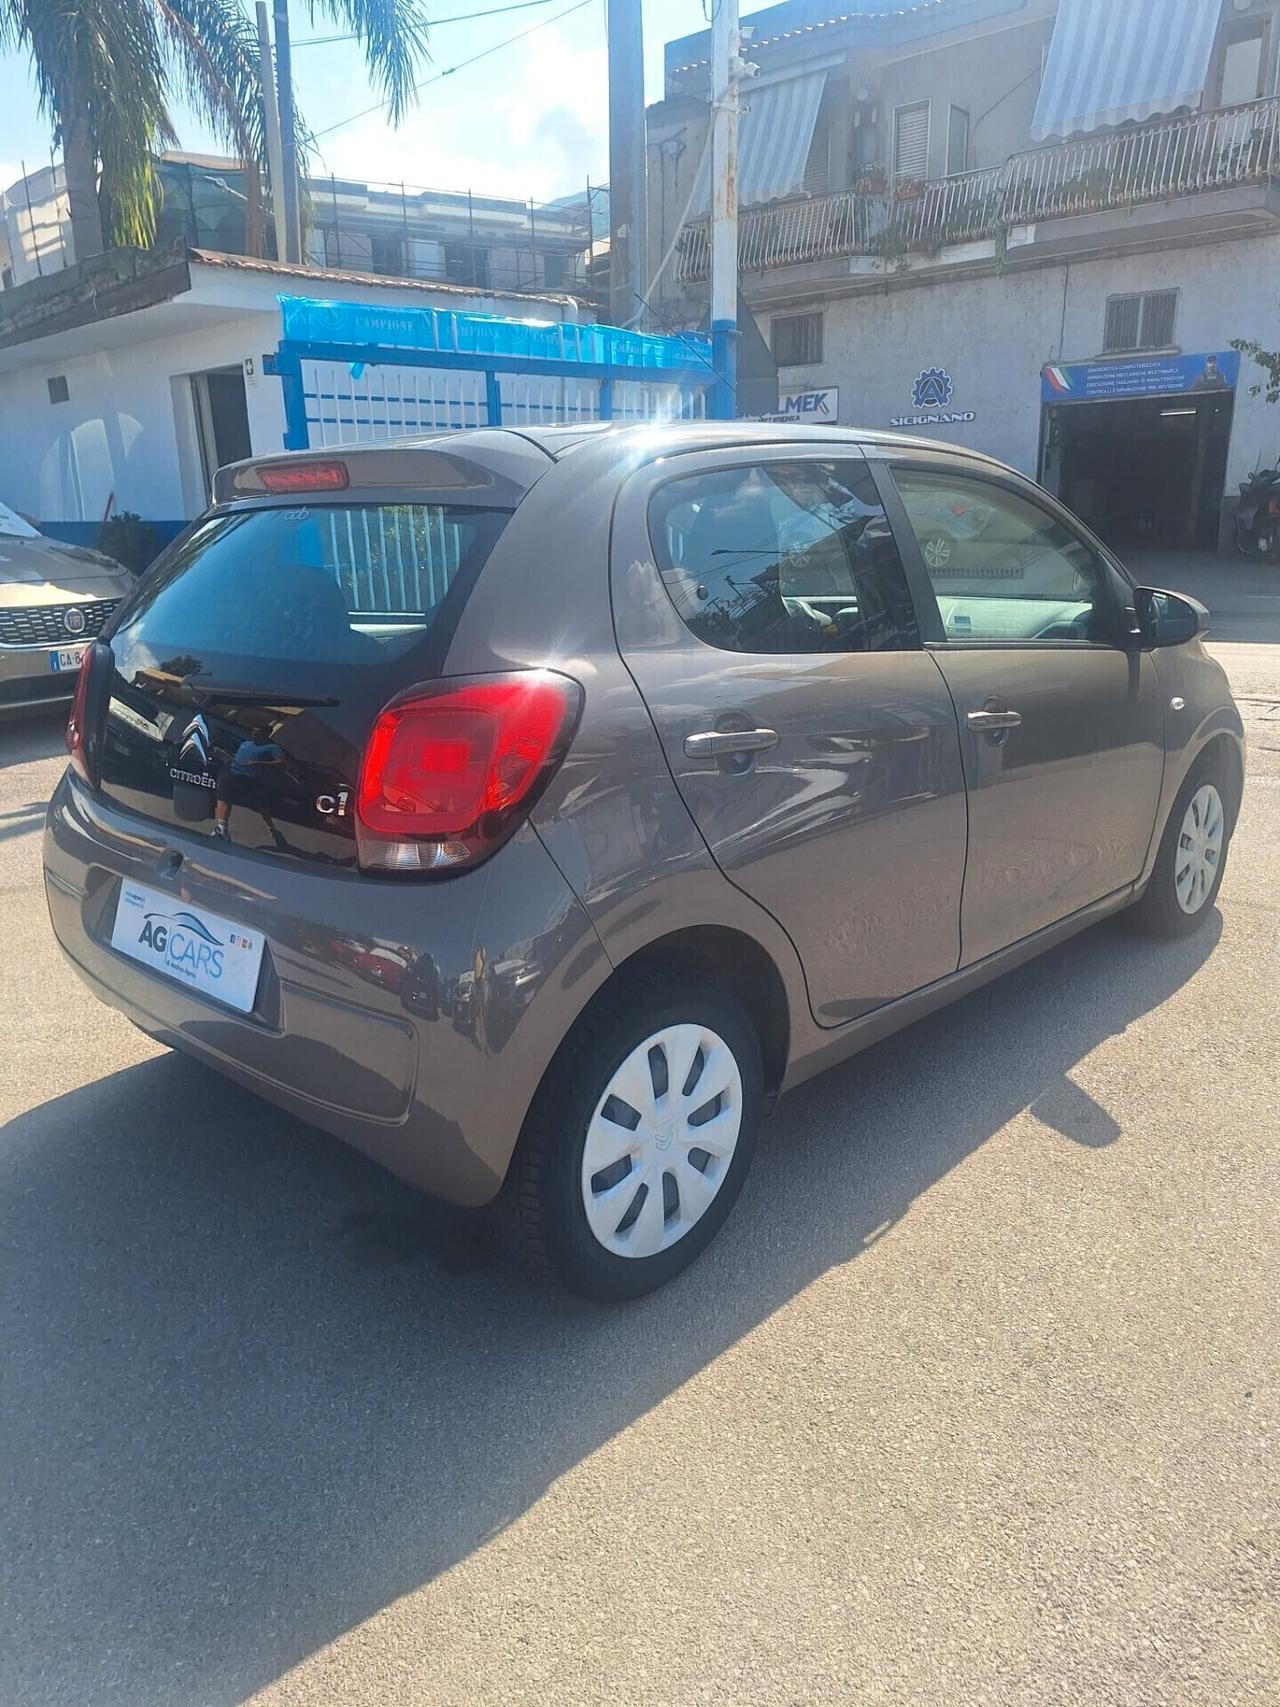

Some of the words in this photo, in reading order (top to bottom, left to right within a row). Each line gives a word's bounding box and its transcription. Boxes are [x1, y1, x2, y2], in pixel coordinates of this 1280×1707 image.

[354, 315, 414, 332] CAMPIONE
[889, 410, 975, 426] SICIGNANO
[169, 767, 216, 789] CITROËN
[316, 792, 349, 816] C1
[138, 920, 168, 953] AG
[169, 932, 225, 979] CARS
